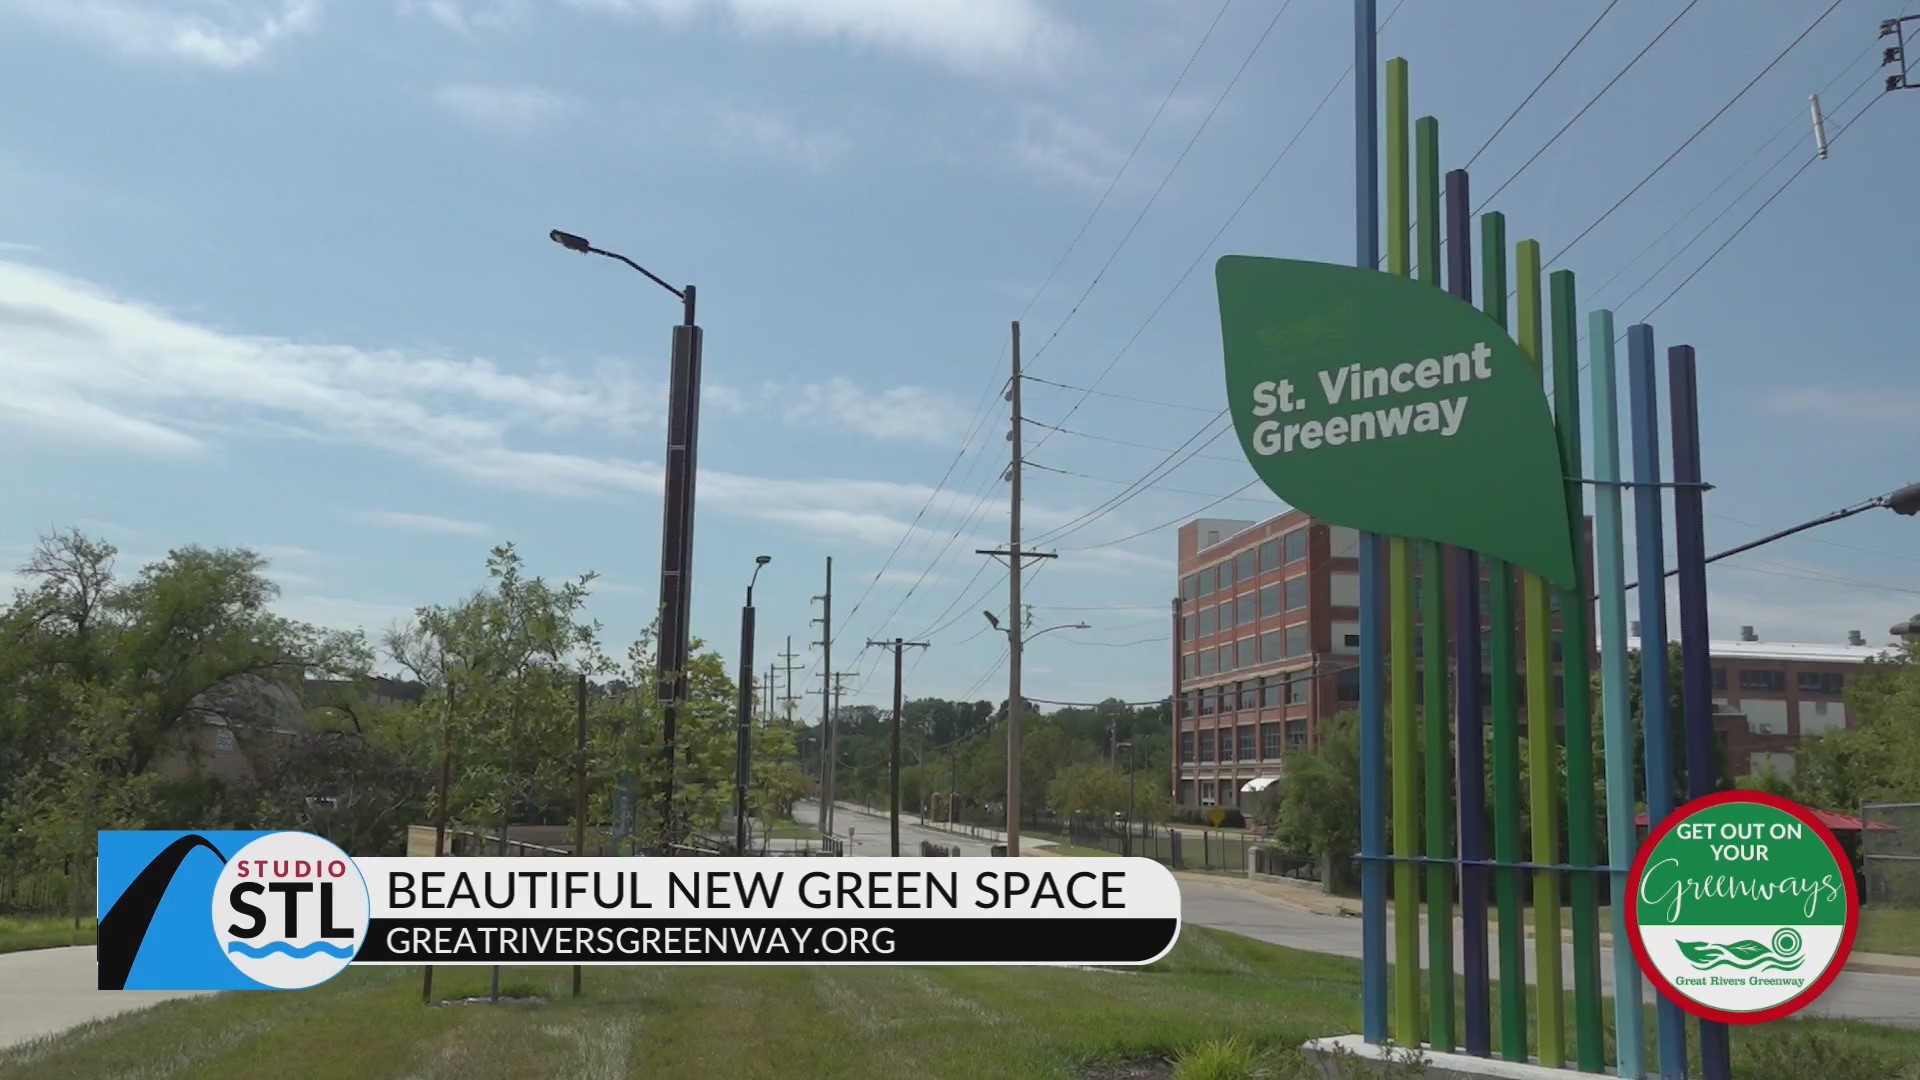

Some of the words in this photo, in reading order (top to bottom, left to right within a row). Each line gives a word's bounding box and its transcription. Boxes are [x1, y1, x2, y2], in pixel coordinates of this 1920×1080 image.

[1252, 379, 1306, 417] St.
[1317, 342, 1492, 405] Vincent
[1252, 396, 1469, 456] Greenway
